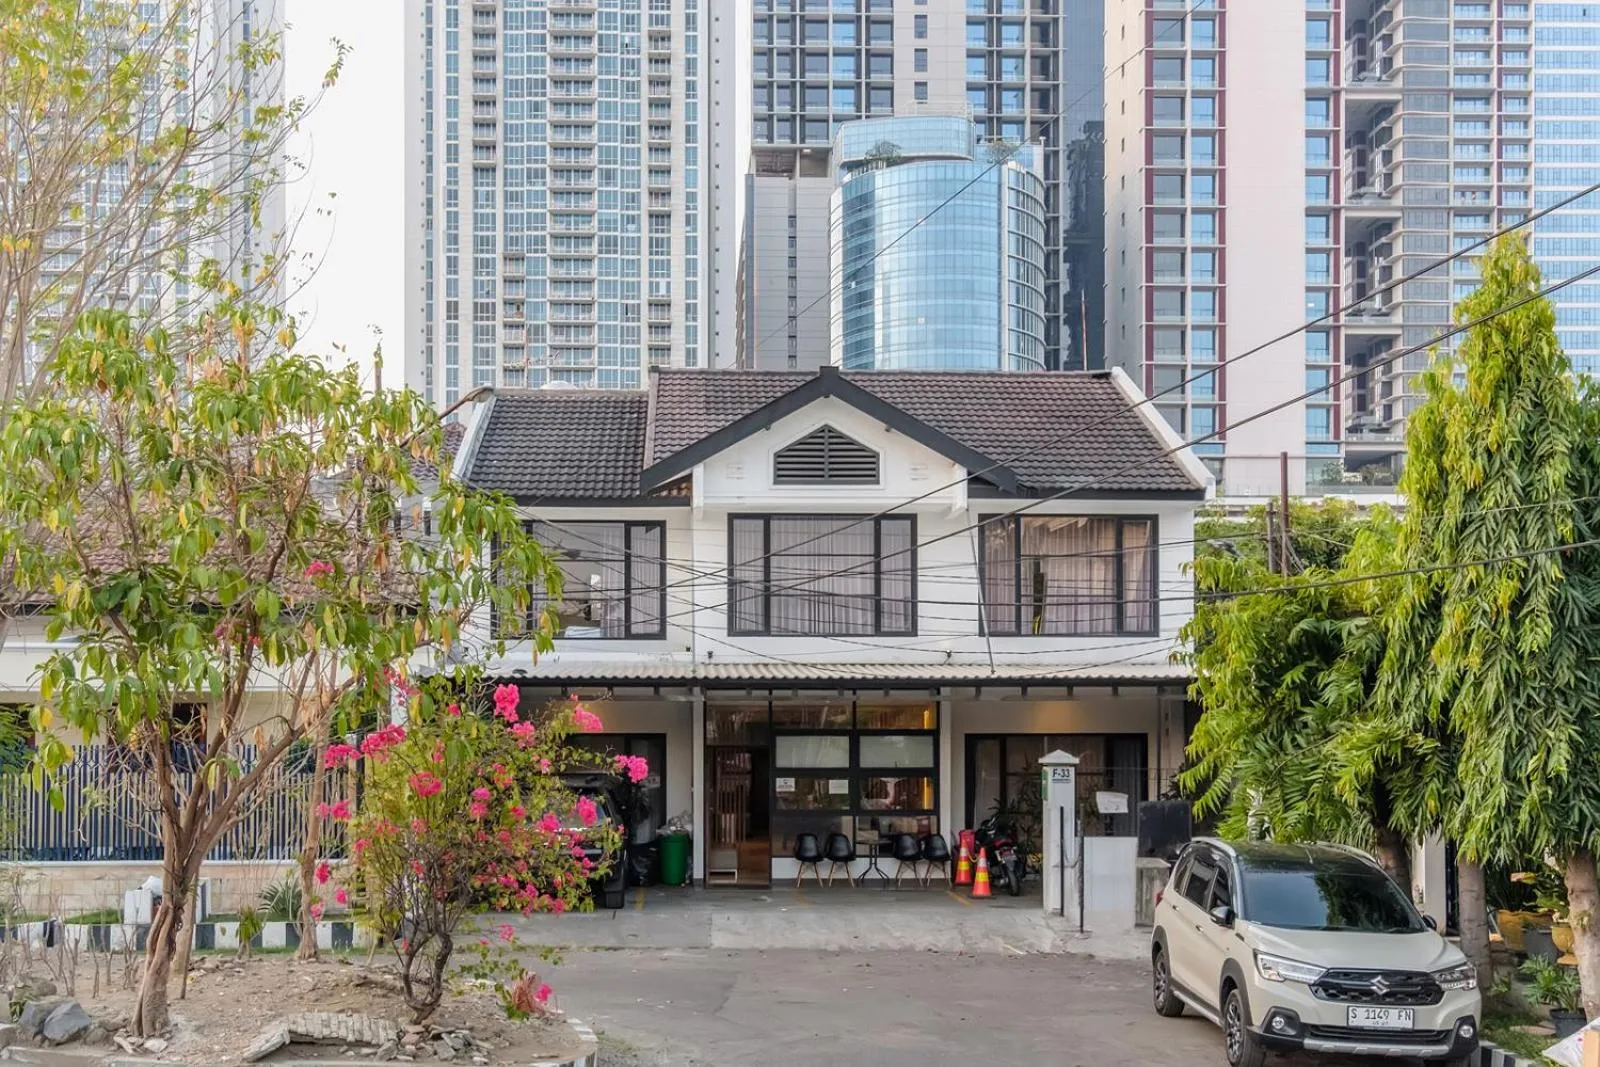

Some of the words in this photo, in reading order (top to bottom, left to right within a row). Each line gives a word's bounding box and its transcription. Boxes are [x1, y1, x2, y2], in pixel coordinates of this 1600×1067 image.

[1052, 768, 1070, 778] F-33
[1351, 1008, 1357, 1019] S
[1364, 1009, 1389, 1020] 1149
[1398, 1010, 1411, 1021] FN
